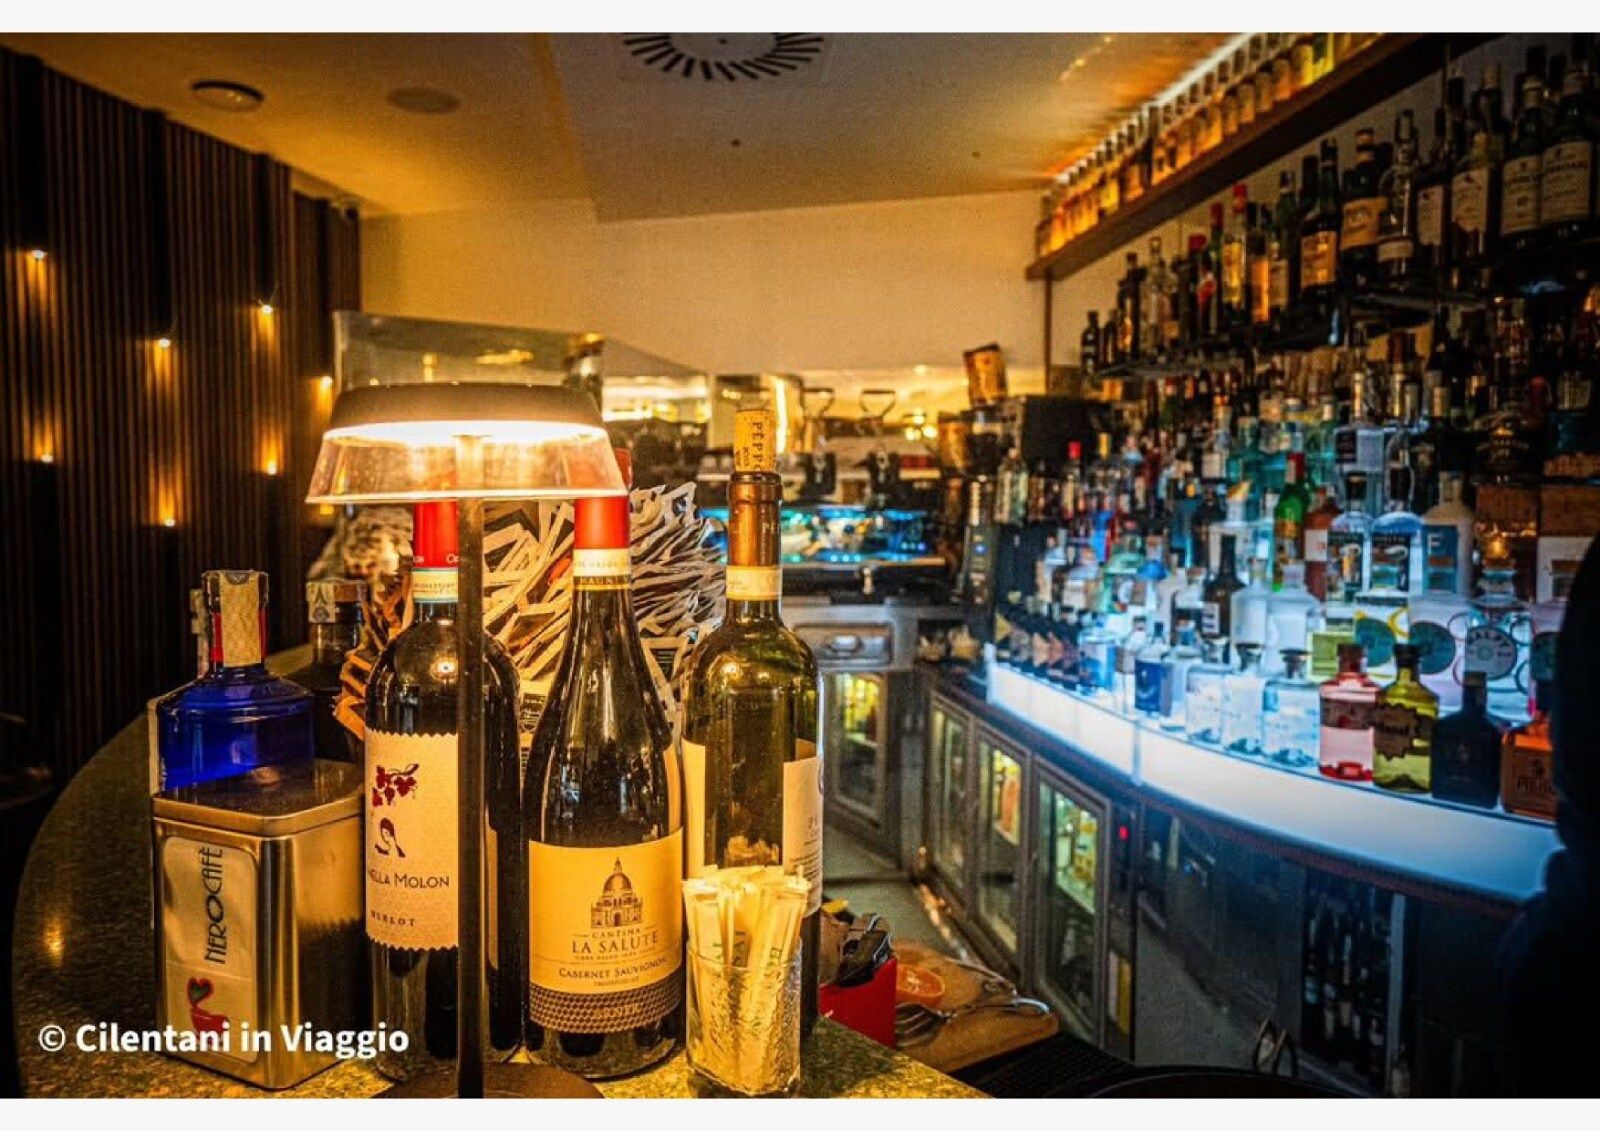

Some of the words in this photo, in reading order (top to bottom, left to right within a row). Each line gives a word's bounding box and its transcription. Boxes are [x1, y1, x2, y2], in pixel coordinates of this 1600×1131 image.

[394, 872, 450, 889] MOLON
[571, 939, 592, 954] LA
[598, 930, 658, 954] SALUTE
[591, 928, 641, 939] CANTINA
[558, 967, 610, 979] CABERNET
[614, 956, 668, 976] SAUVIGNON
